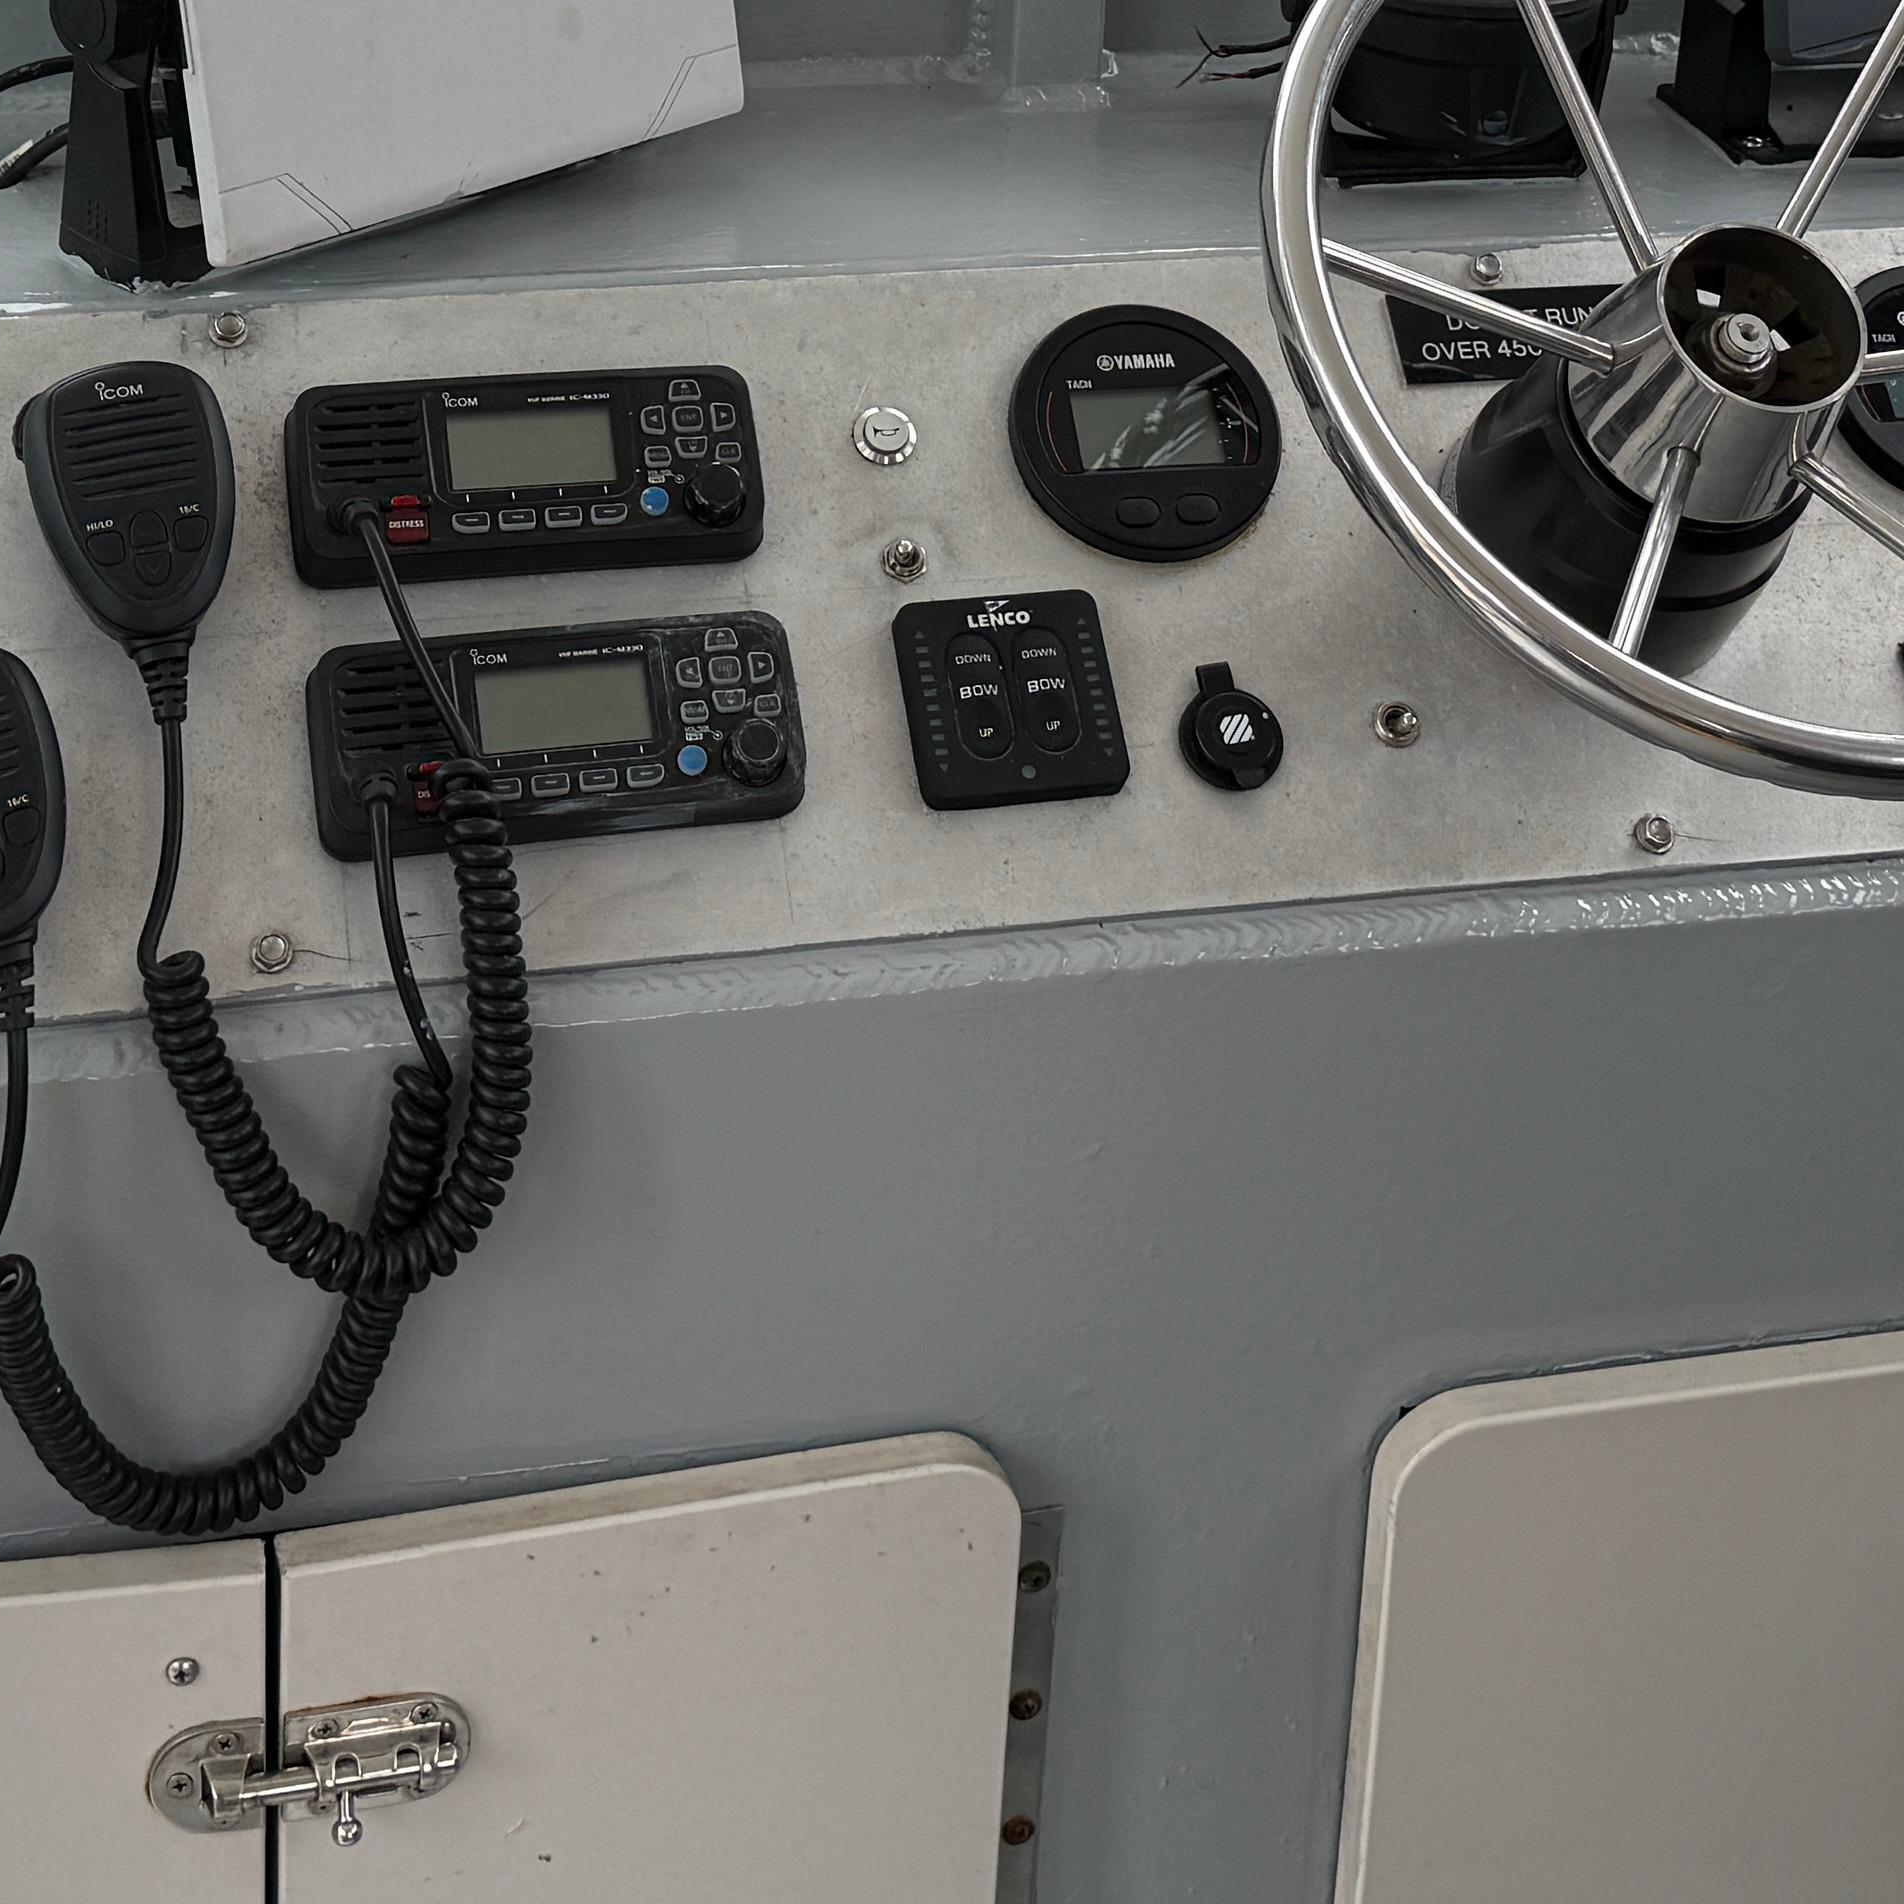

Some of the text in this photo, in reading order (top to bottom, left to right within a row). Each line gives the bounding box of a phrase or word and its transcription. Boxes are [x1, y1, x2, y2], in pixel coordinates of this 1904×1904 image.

[1421, 341, 1492, 361] OVER
[1113, 353, 1176, 370] YAMAHA
[966, 610, 1031, 629] LENCO
[955, 653, 992, 665] DOWN
[1021, 647, 1057, 659] DOWN
[959, 683, 999, 699] BOW
[1027, 678, 1065, 693] BOW
[978, 727, 994, 738] UP
[1045, 720, 1061, 731] UP
